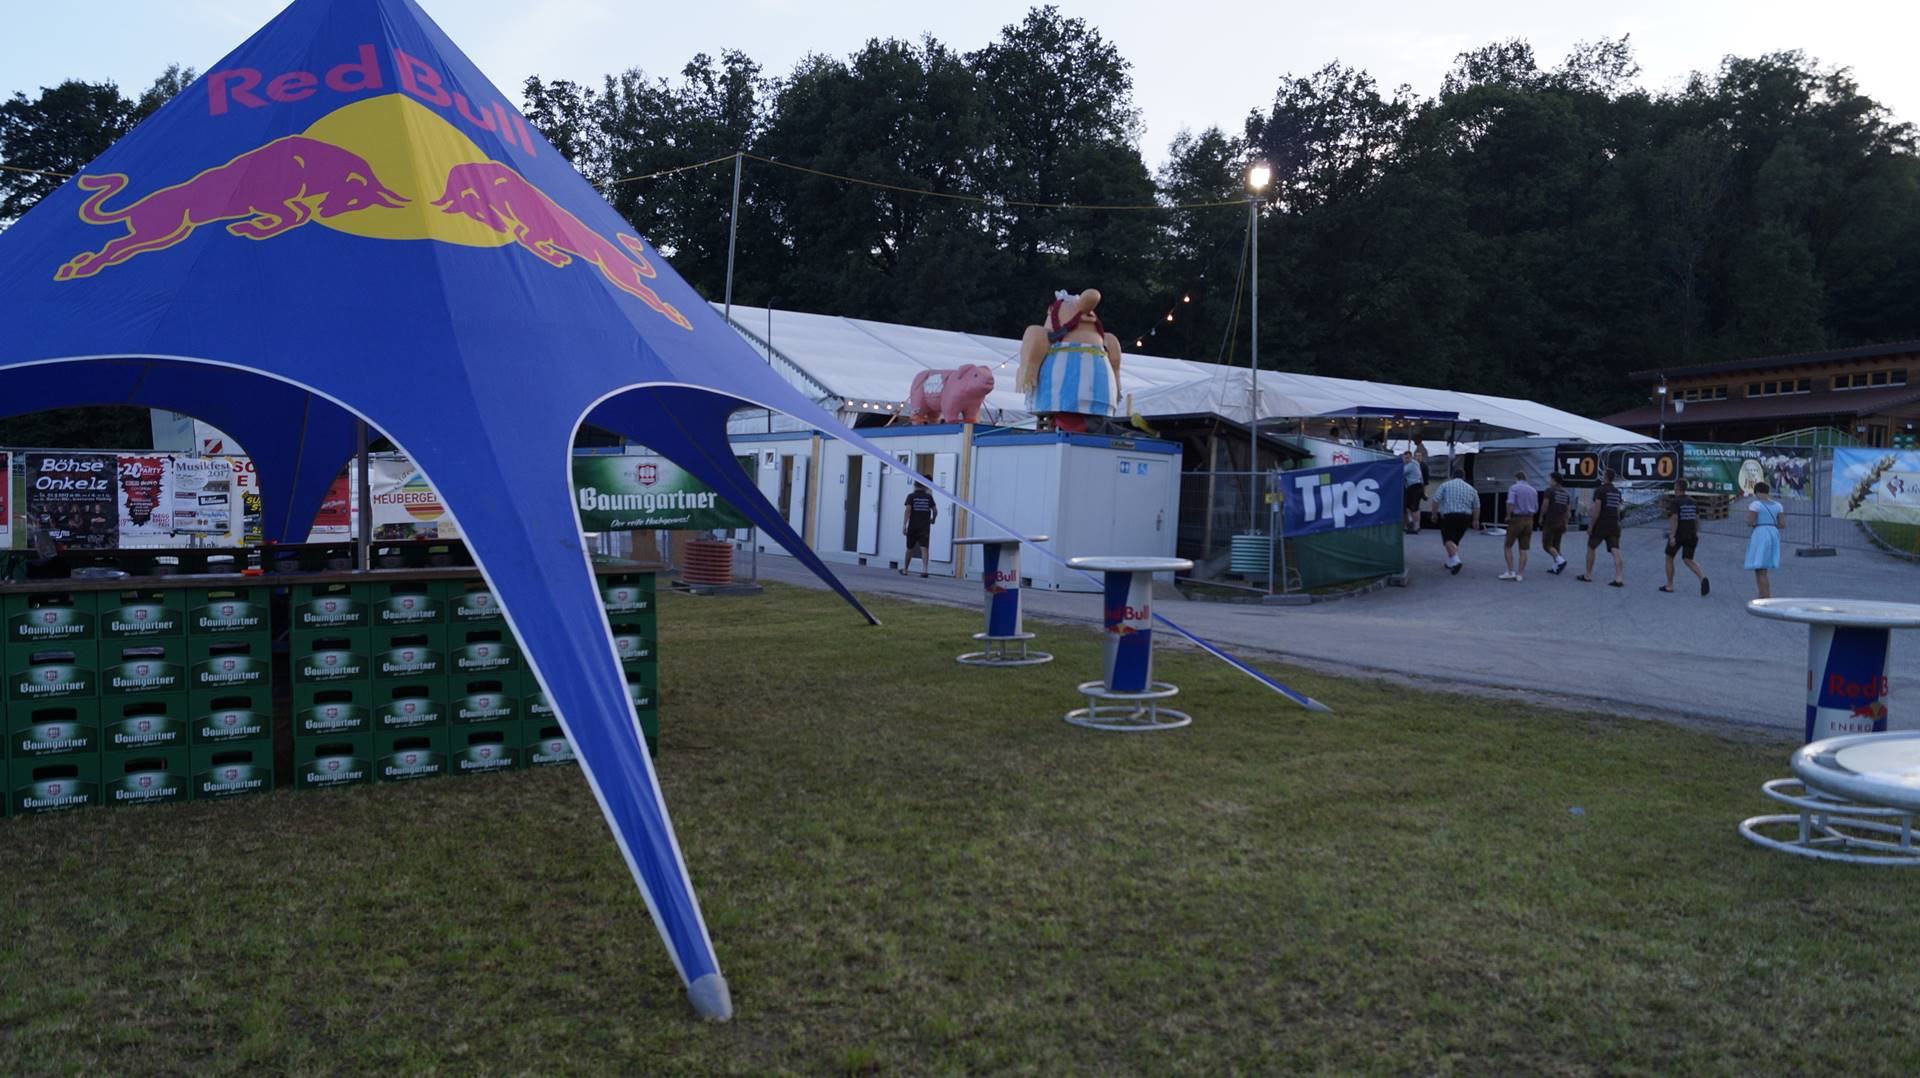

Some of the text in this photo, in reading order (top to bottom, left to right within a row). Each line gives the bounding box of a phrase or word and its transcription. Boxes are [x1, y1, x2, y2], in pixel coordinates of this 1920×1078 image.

[207, 44, 538, 159] Red Bull
[40, 458, 104, 472] Böhse
[176, 461, 230, 471] Musikfest
[1627, 455, 1674, 477] LT1
[208, 470, 230, 478] 2017
[36, 476, 108, 490] Onkelz
[579, 486, 718, 513] Baumgartner
[1295, 473, 1381, 528] Tips
[303, 612, 360, 623] Baumgartner
[382, 609, 436, 620] Baumgartner
[1123, 605, 1149, 620] Bull
[111, 619, 173, 632] Baumgartner
[199, 616, 259, 628] Baumgartner
[19, 624, 85, 636] Baumgartner
[382, 661, 436, 673] Baumgartner
[458, 656, 510, 667] Baumgartner
[200, 670, 260, 682] Baumgartner
[304, 665, 360, 677] Baumgartner
[20, 681, 86, 693] Baumgartner
[112, 676, 175, 688] Baumgartner
[1828, 671, 1877, 698] Red
[459, 707, 511, 718] Baumgartner
[305, 718, 361, 730] Baumgartner
[384, 713, 437, 725] Baumgartner
[202, 724, 261, 737] Baumgartner
[114, 731, 177, 744] Baumgartner
[22, 737, 88, 751] Baumgartner
[460, 758, 512, 769] Baumgartner
[307, 769, 363, 782] Baumgartner
[385, 764, 438, 776] Baumgartner
[203, 779, 262, 792] Baumgartner
[116, 786, 178, 800] Baumgartner
[23, 794, 88, 808] Baumgartner
